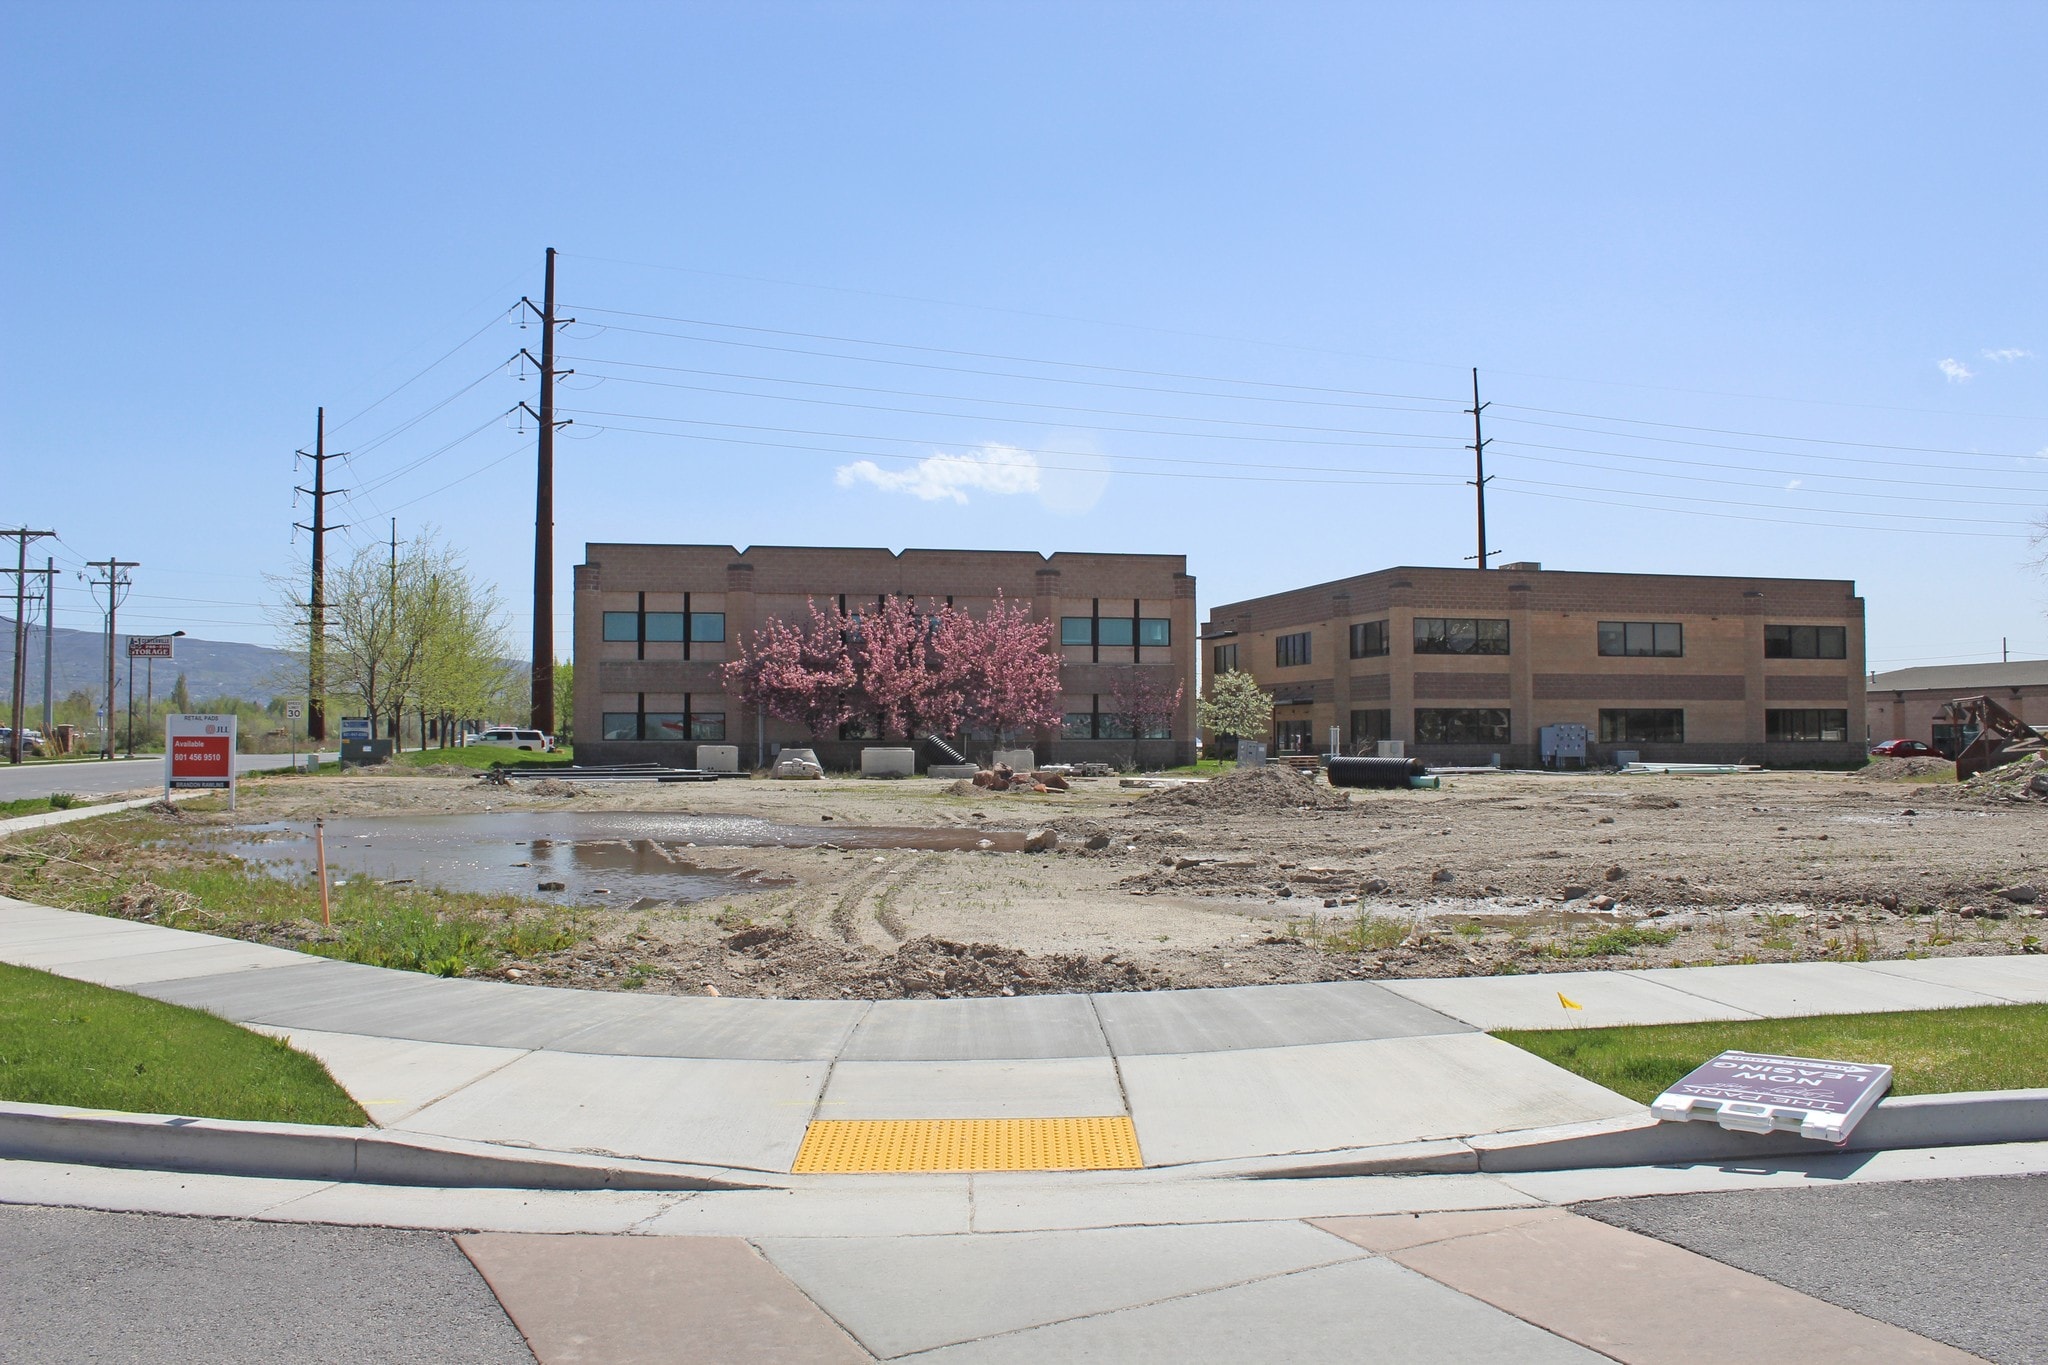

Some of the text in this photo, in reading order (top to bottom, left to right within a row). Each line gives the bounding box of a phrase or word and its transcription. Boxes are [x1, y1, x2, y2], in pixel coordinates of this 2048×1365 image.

[288, 710, 301, 718] 30
[174, 740, 205, 748] Available
[174, 753, 221, 761] 801 456 9510
[1712, 1061, 1868, 1082] LEASING
[1731, 1071, 1823, 1086] NOW
[1681, 1086, 1762, 1101] PARK
[1769, 1096, 1836, 1111] THE
